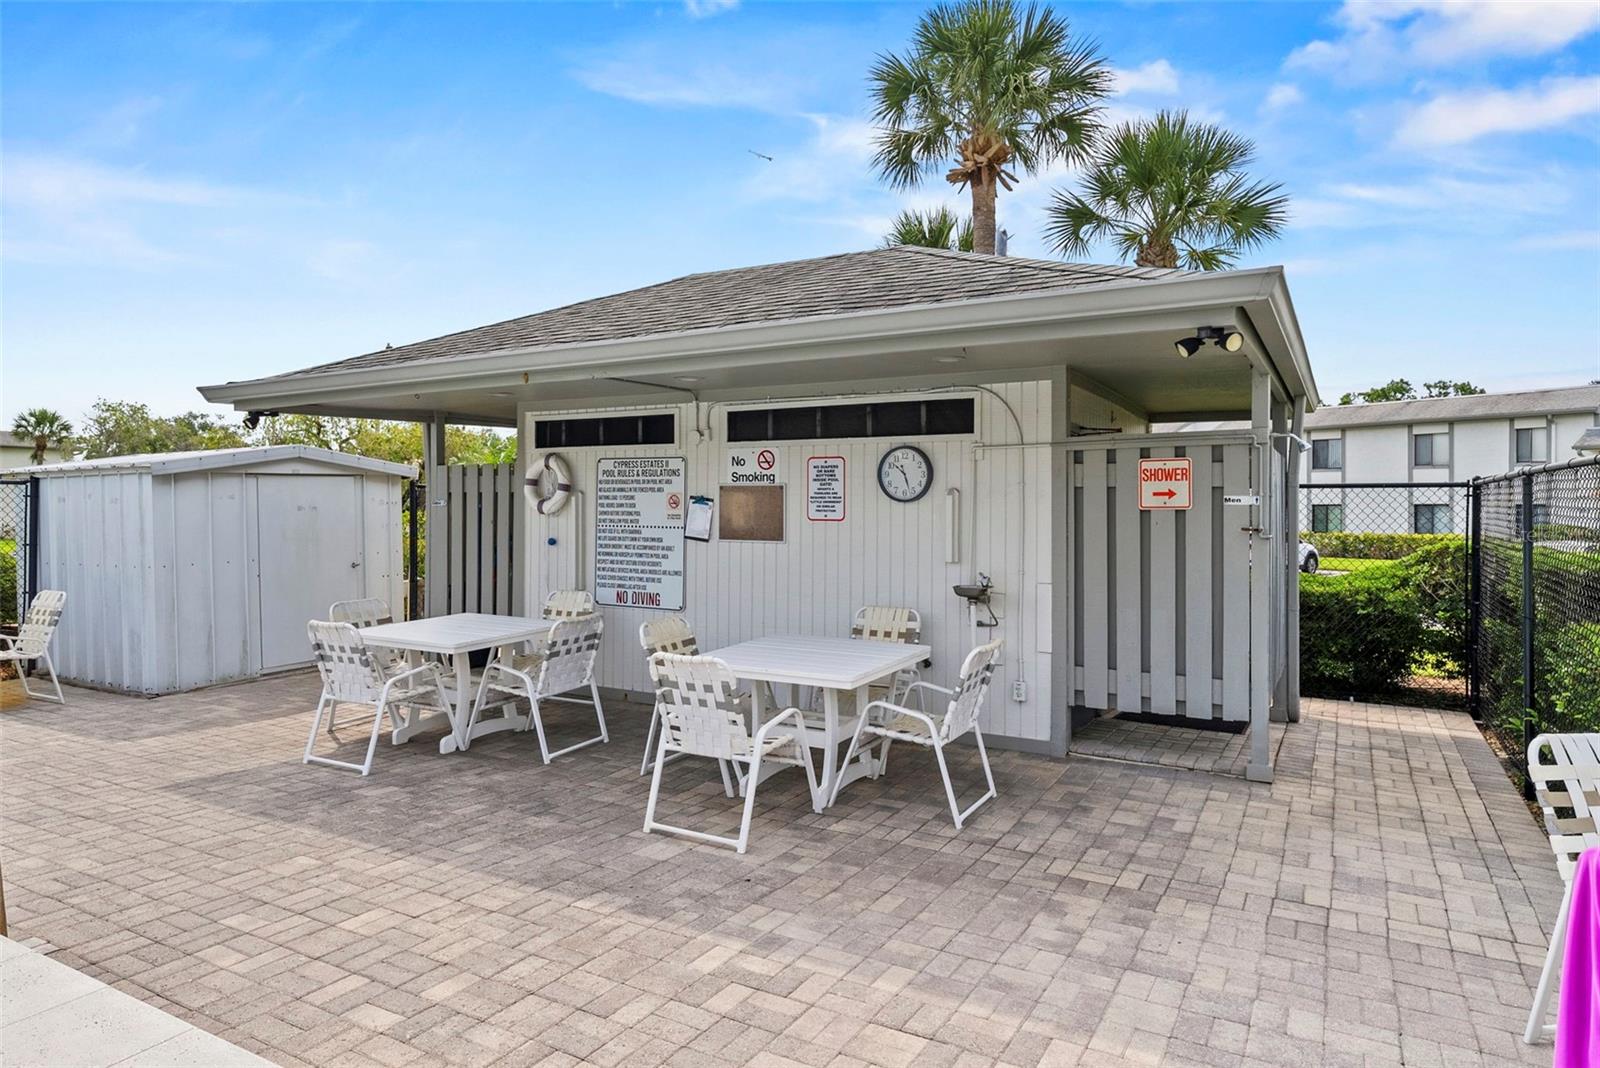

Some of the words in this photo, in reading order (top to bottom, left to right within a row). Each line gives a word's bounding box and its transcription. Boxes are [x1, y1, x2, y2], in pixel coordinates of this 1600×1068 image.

[613, 460, 639, 469] CYPRESS
[640, 460, 665, 468] ESTATES
[731, 456, 746, 466] No
[602, 469, 616, 477] POOL
[617, 469, 635, 477] RULES
[641, 469, 680, 477] REGULATIONS
[731, 472, 775, 484] Smoking
[1142, 468, 1188, 482] SHOWER
[616, 590, 628, 604] NO
[632, 592, 660, 606] DIVING
